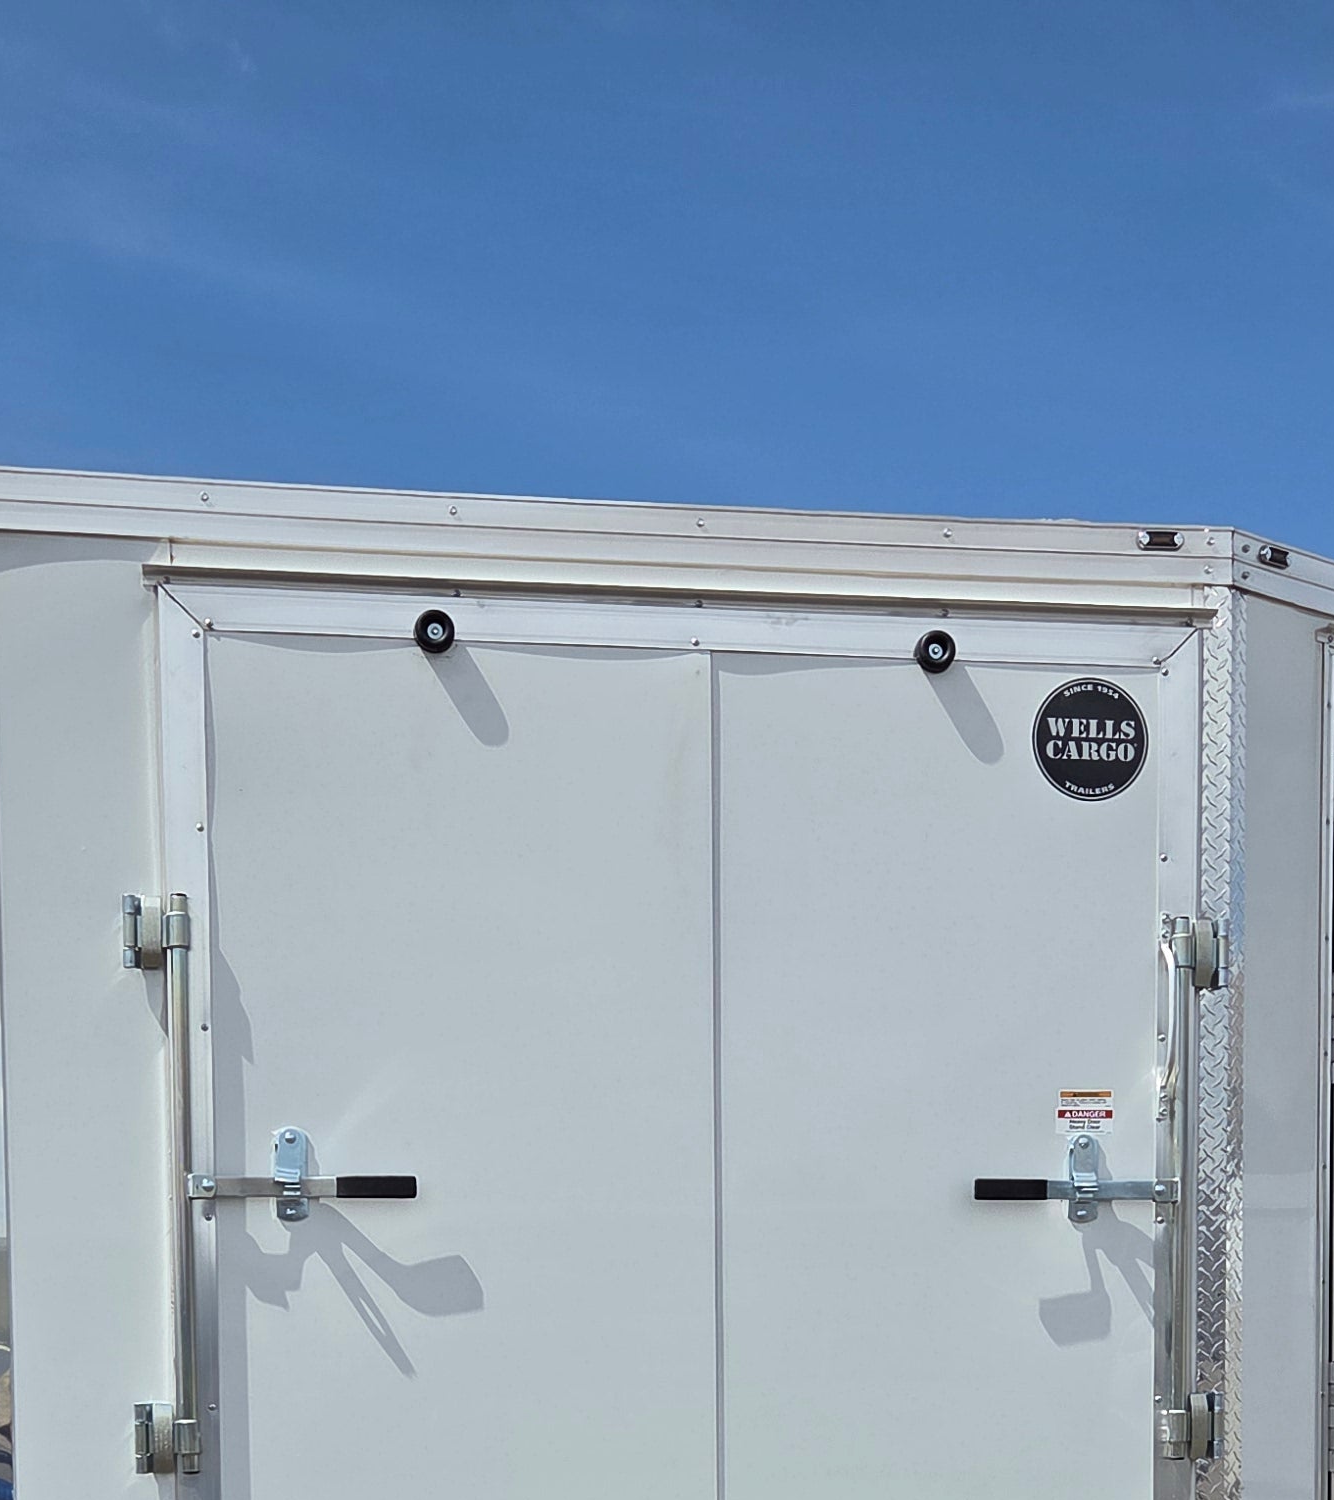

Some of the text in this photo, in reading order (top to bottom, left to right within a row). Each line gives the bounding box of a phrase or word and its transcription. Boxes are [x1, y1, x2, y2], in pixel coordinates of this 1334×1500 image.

[1063, 684, 1093, 697] SINCE
[1046, 717, 1136, 740] WELLS
[1045, 739, 1136, 762] CARGO
[1064, 781, 1115, 795] TRAILERS
[1072, 1110, 1106, 1118] DANGER
